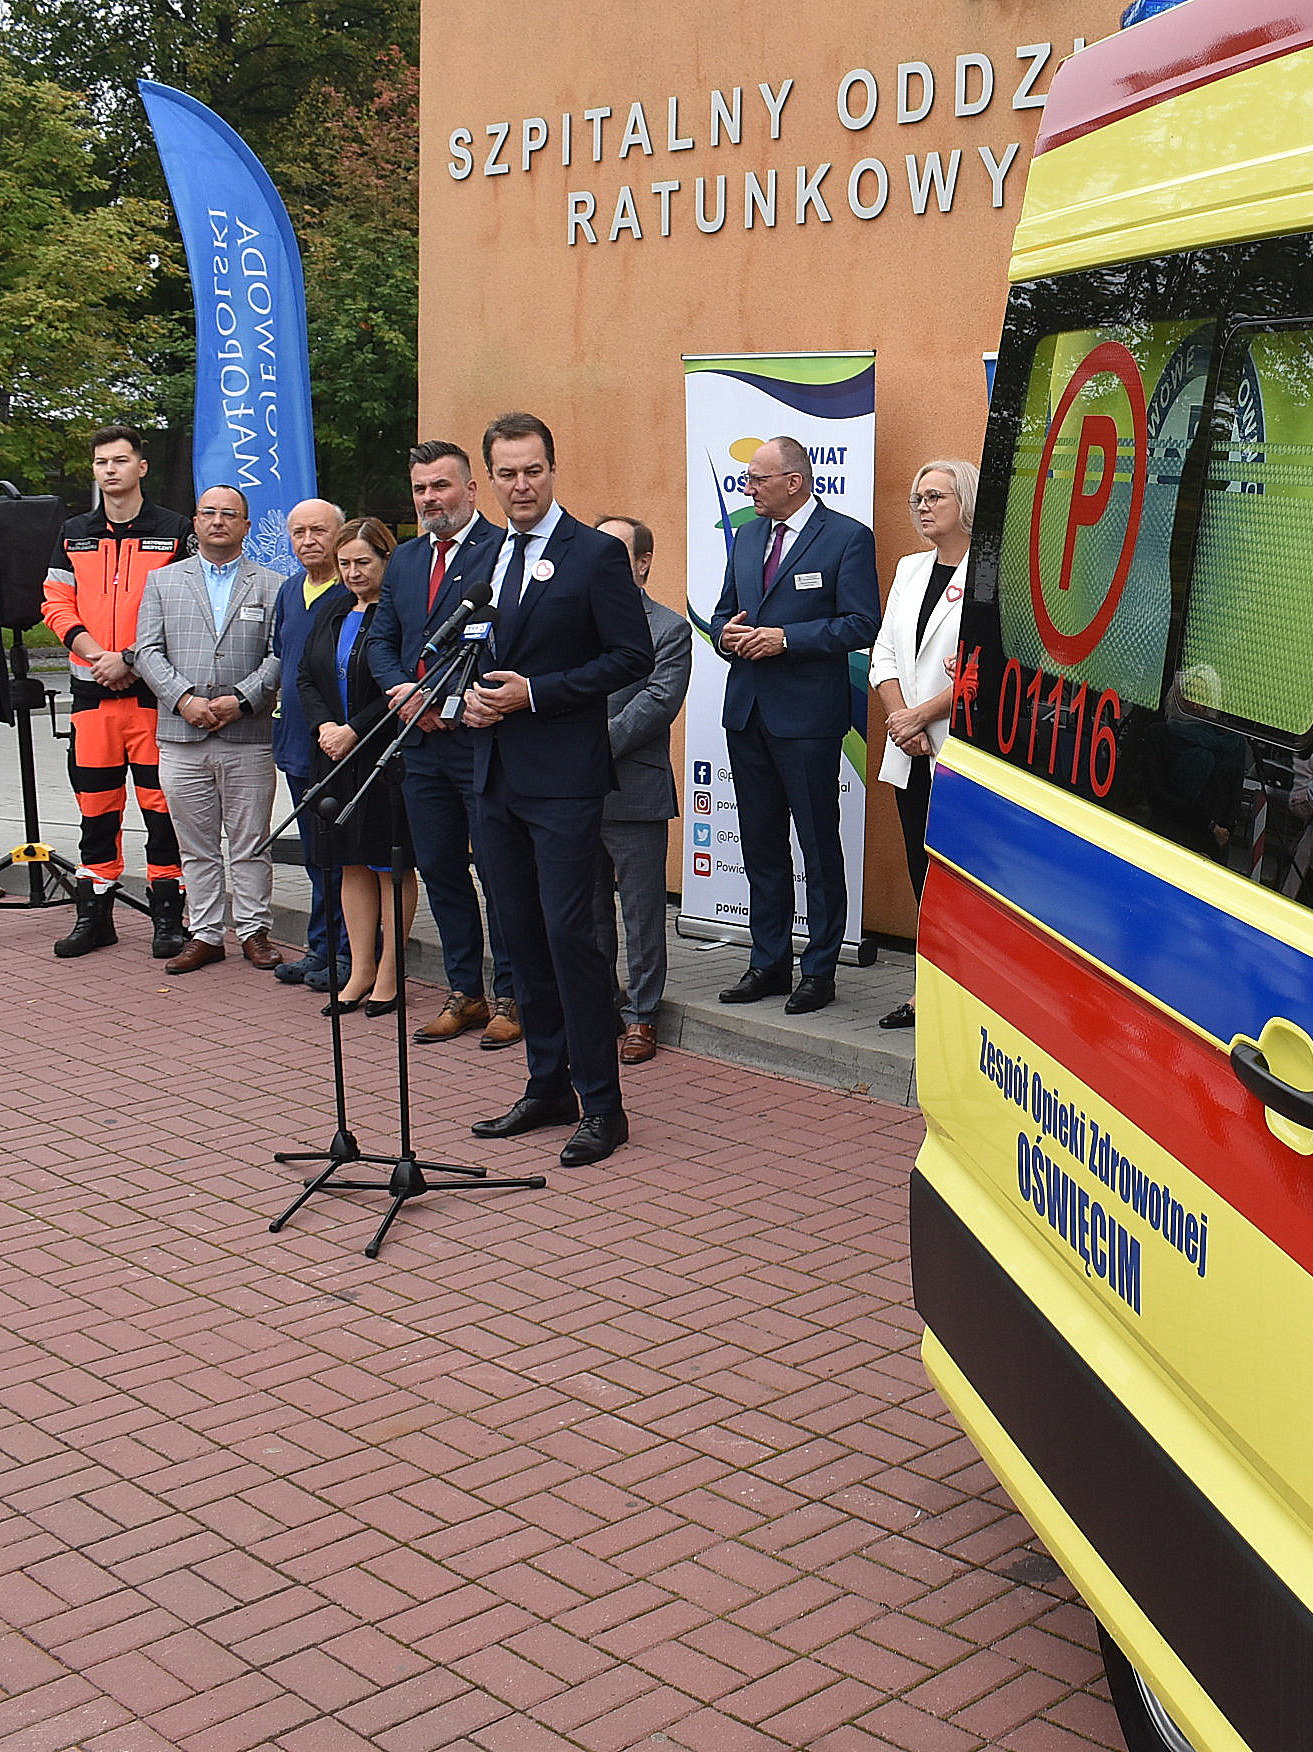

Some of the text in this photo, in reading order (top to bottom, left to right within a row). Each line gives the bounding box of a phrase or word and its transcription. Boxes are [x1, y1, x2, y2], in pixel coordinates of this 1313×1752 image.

[448, 79, 794, 181] SZPITALNY
[566, 142, 1020, 246] RATUNKOWY
[803, 446, 848, 465] WIAT
[1058, 414, 1118, 591] P
[951, 639, 1121, 798] K 01116
[716, 860, 745, 874] Powia
[979, 1025, 1208, 1278] Zespół Opieki Zdrowotnej
[1017, 1131, 1141, 1317] OŚWIĘCIM
